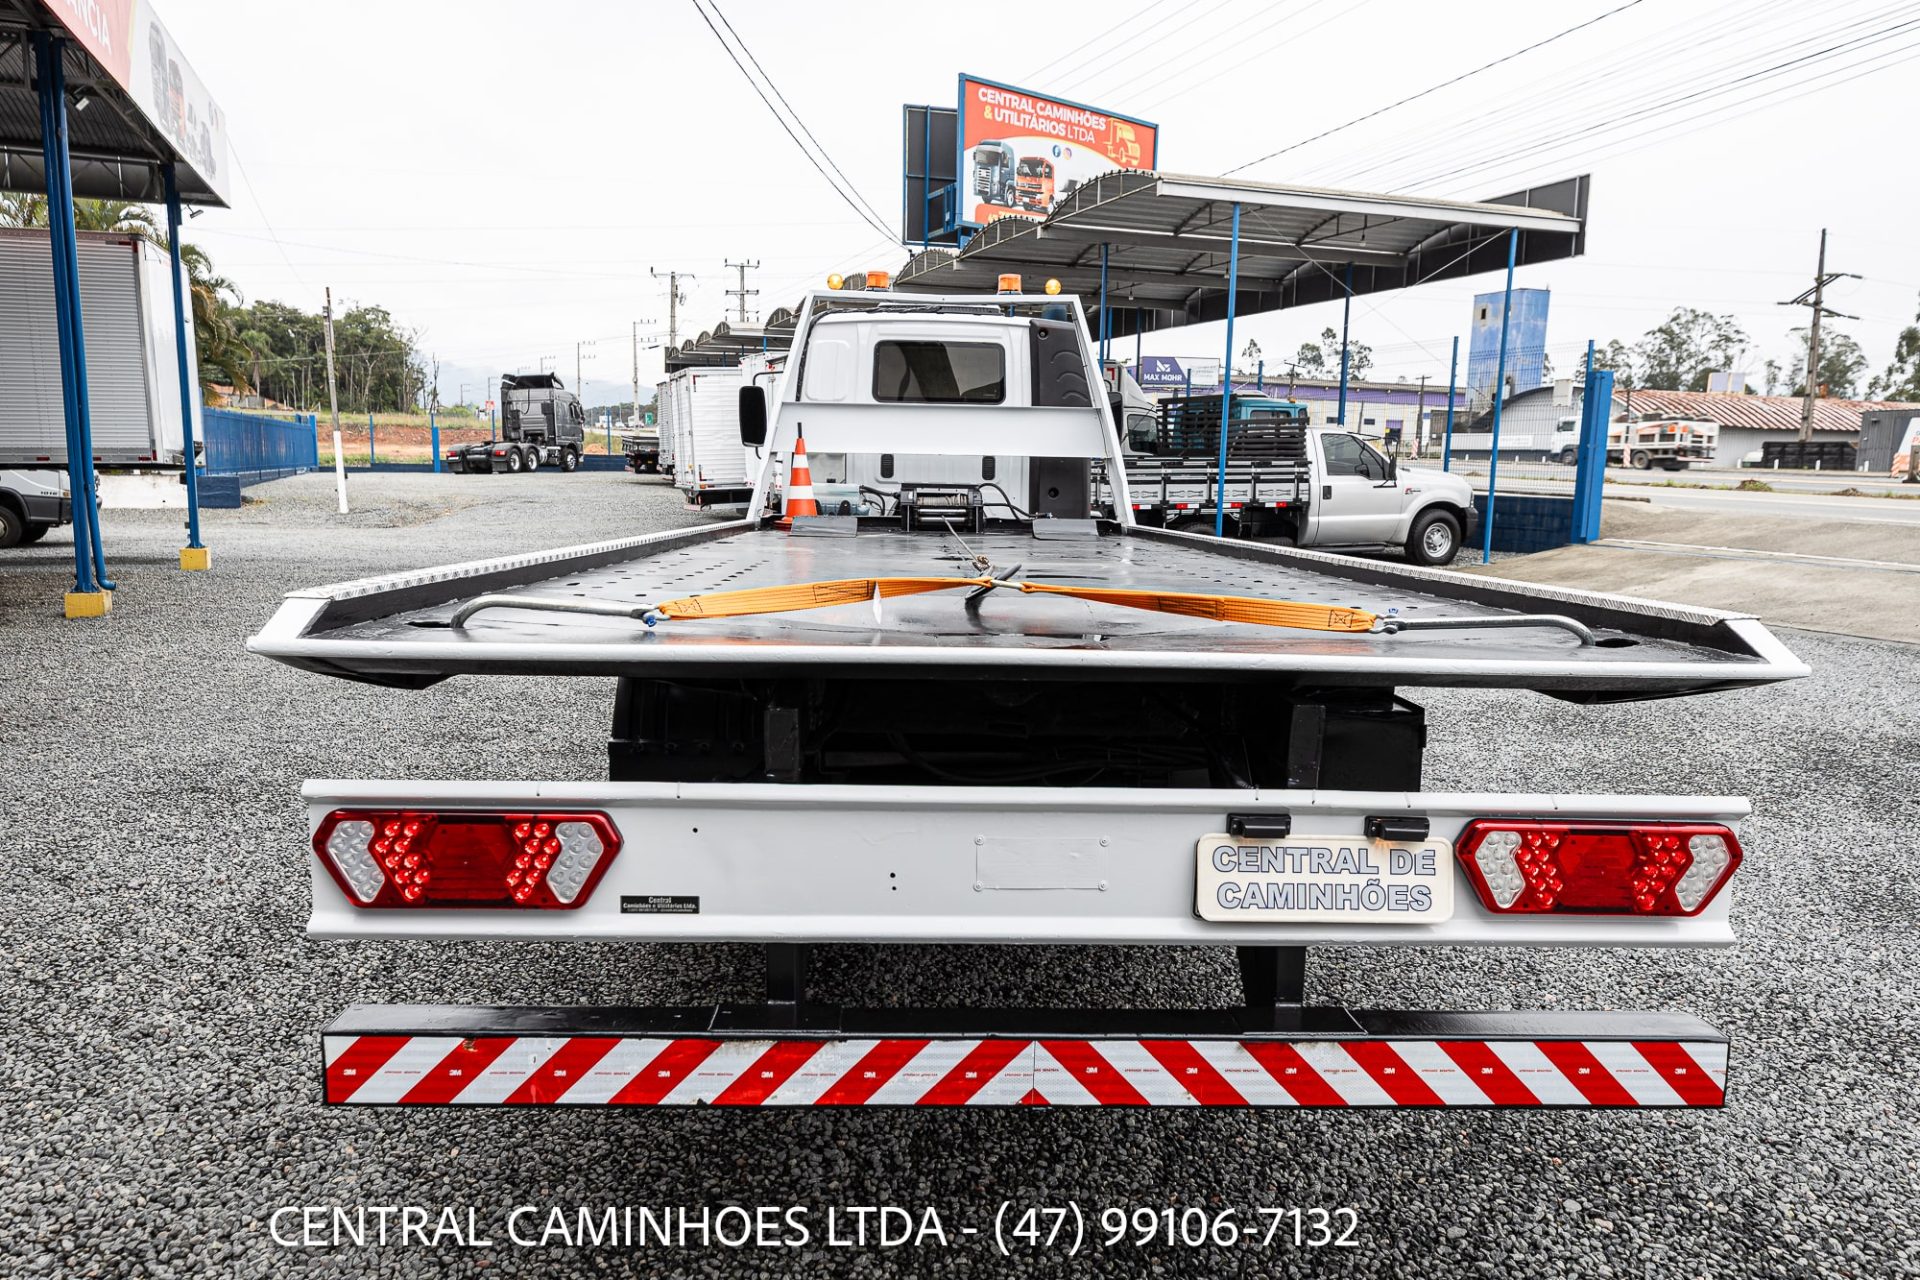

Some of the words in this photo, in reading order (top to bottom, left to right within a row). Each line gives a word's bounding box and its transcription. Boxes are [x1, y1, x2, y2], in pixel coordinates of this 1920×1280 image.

[978, 88, 1035, 113] CENTRAL
[1036, 102, 1106, 130] CAMINHÕES
[984, 105, 993, 120] &
[994, 107, 1066, 136] UTILITÁRIOS
[1067, 125, 1095, 143] LTDA
[1143, 373, 1160, 381] MAX
[1161, 374, 1183, 382] MOHR
[1212, 846, 1379, 874] CENTRAL
[1390, 849, 1436, 875] DE
[1217, 879, 1432, 911] CAMINHÕES
[648, 896, 672, 904] Central
[343, 1068, 356, 1076] 3M
[553, 1069, 566, 1077] 3M
[657, 1070, 670, 1078] 3M
[1085, 1066, 1097, 1074] 3M
[1285, 1067, 1296, 1075] 3M
[1383, 1067, 1395, 1075] 3M
[1481, 1067, 1493, 1075] 3M
[1578, 1067, 1590, 1075] 3M
[1674, 1067, 1686, 1075] 3M
[760, 1071, 773, 1079] 3M
[863, 1071, 875, 1079] 3M
[965, 1071, 977, 1079] 3M
